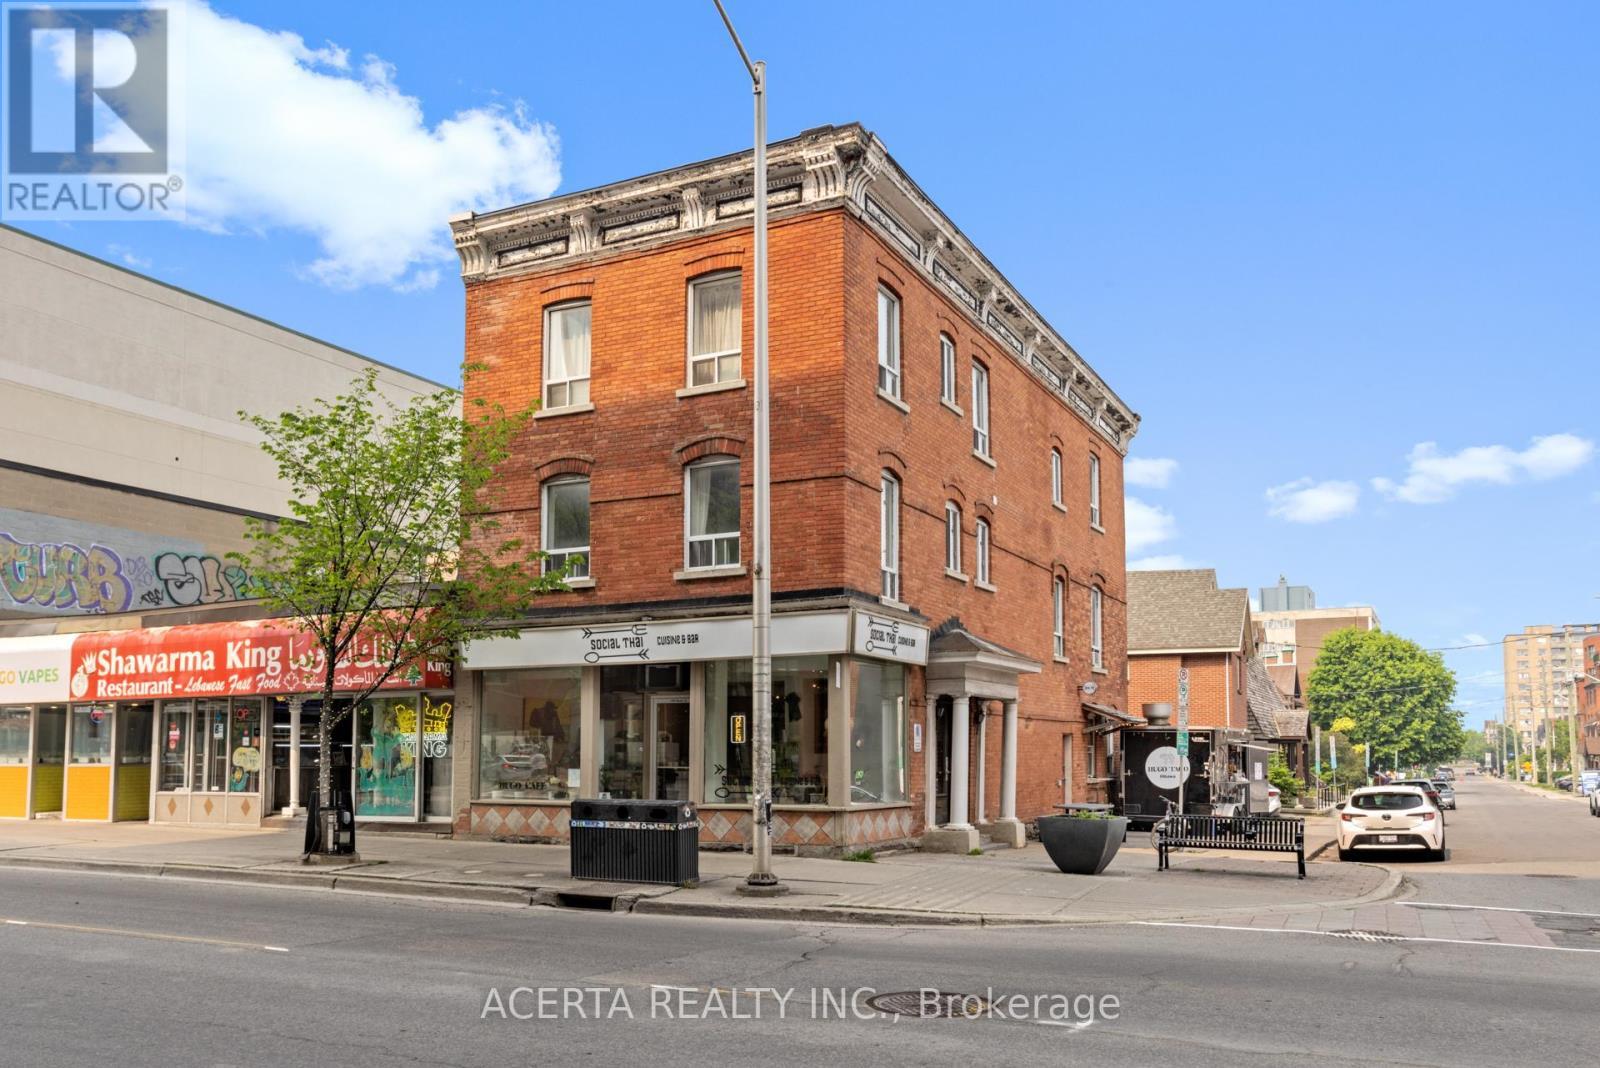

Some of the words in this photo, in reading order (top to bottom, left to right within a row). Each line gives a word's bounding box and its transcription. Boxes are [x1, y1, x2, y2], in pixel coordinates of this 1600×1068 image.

[590, 638, 620, 650] SOCIAL
[657, 636, 680, 645] CUISINE
[687, 634, 699, 644] BAR
[97, 647, 216, 676] Shawarma
[226, 638, 282, 676] King
[18, 667, 59, 684] VAPES
[97, 677, 173, 697] Restaurant
[184, 676, 225, 692] Lebanese
[228, 674, 252, 694] Fast
[256, 673, 281, 693] Food
